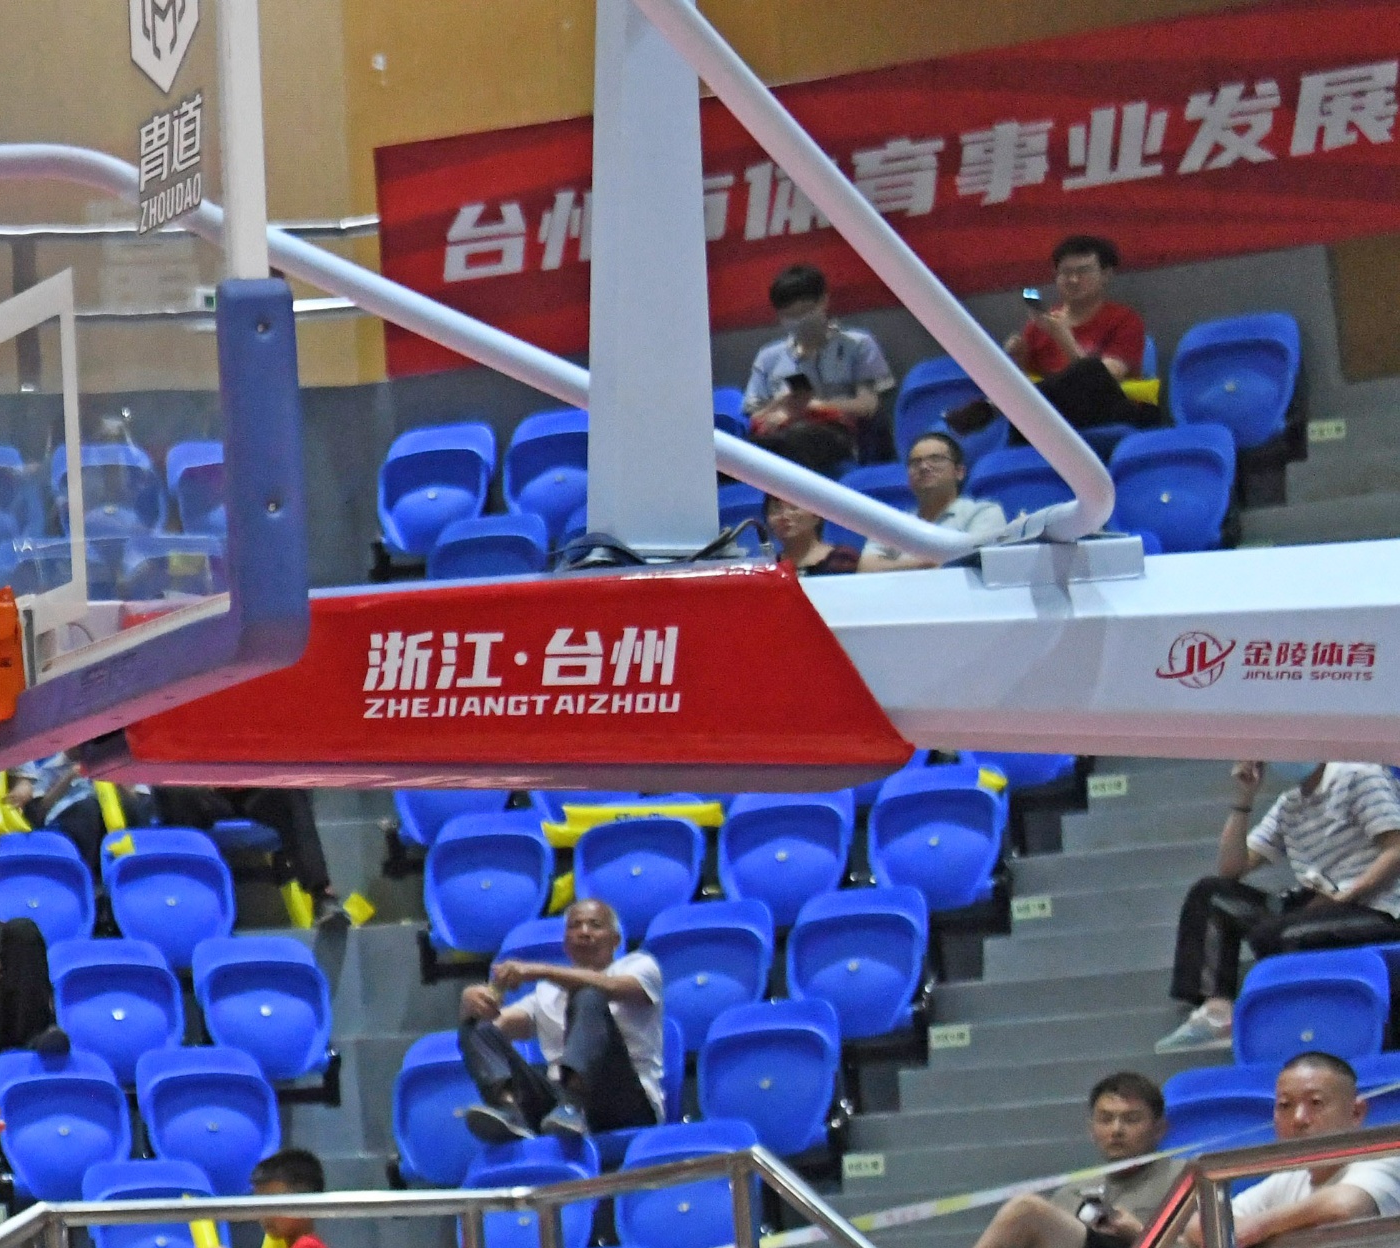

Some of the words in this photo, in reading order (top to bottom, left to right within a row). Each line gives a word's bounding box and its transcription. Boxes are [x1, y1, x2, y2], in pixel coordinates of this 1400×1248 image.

[139, 94, 203, 193] 胄道
[139, 172, 202, 235] ZHOUDAO
[362, 625, 680, 692] 浙江·台州
[1241, 640, 1378, 668] 金陵体育
[1241, 669, 1304, 681] JINLING
[1309, 669, 1375, 681] SPORTS
[362, 692, 682, 719] ZHEJIANGTAIZHOU
